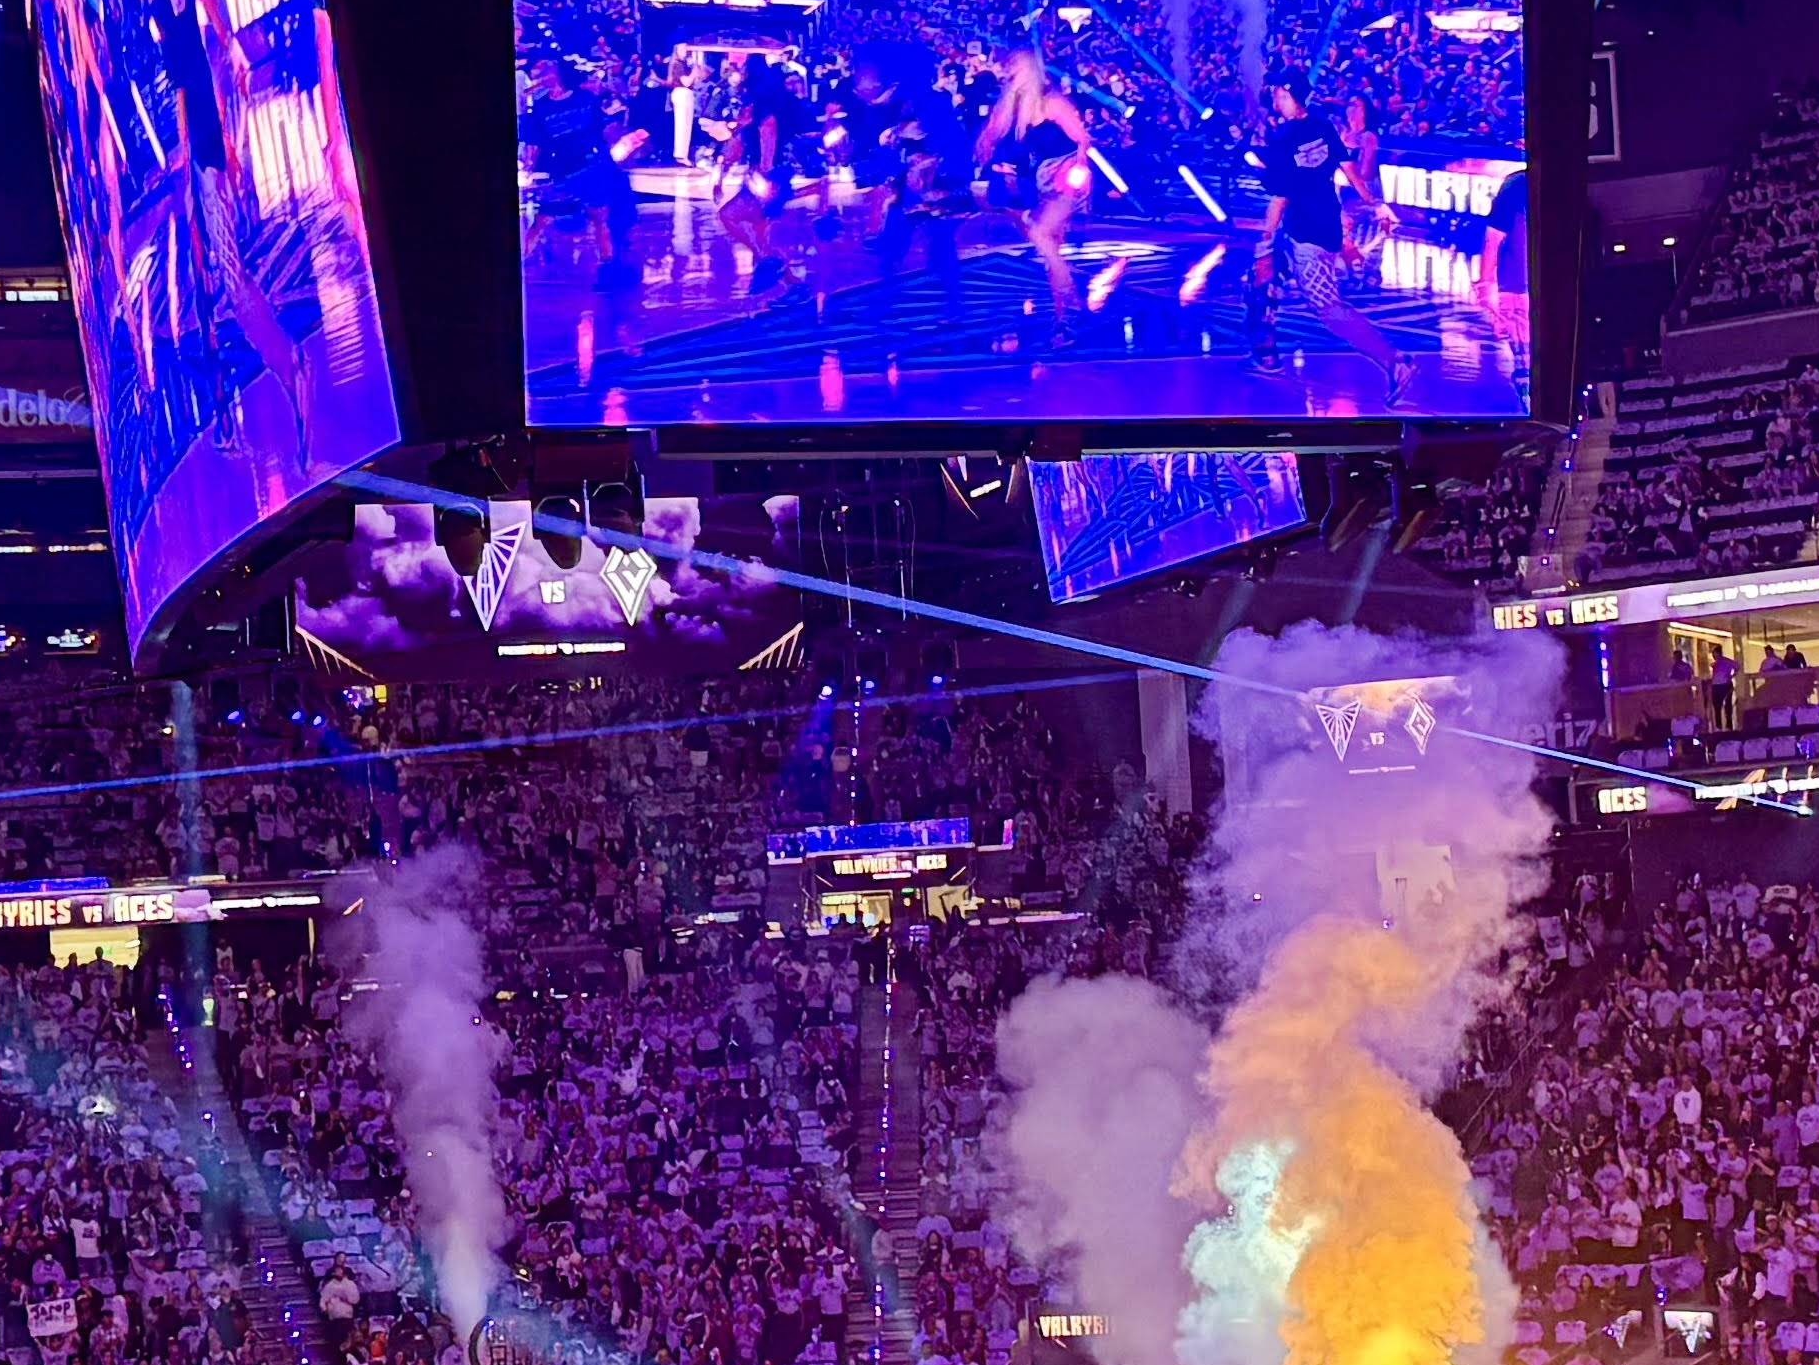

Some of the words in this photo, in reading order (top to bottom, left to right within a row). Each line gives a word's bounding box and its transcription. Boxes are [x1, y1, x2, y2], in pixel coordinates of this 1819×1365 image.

[1570, 594, 1620, 624] ACES
[1598, 786, 1647, 814] ACES
[113, 893, 175, 923] ACES
